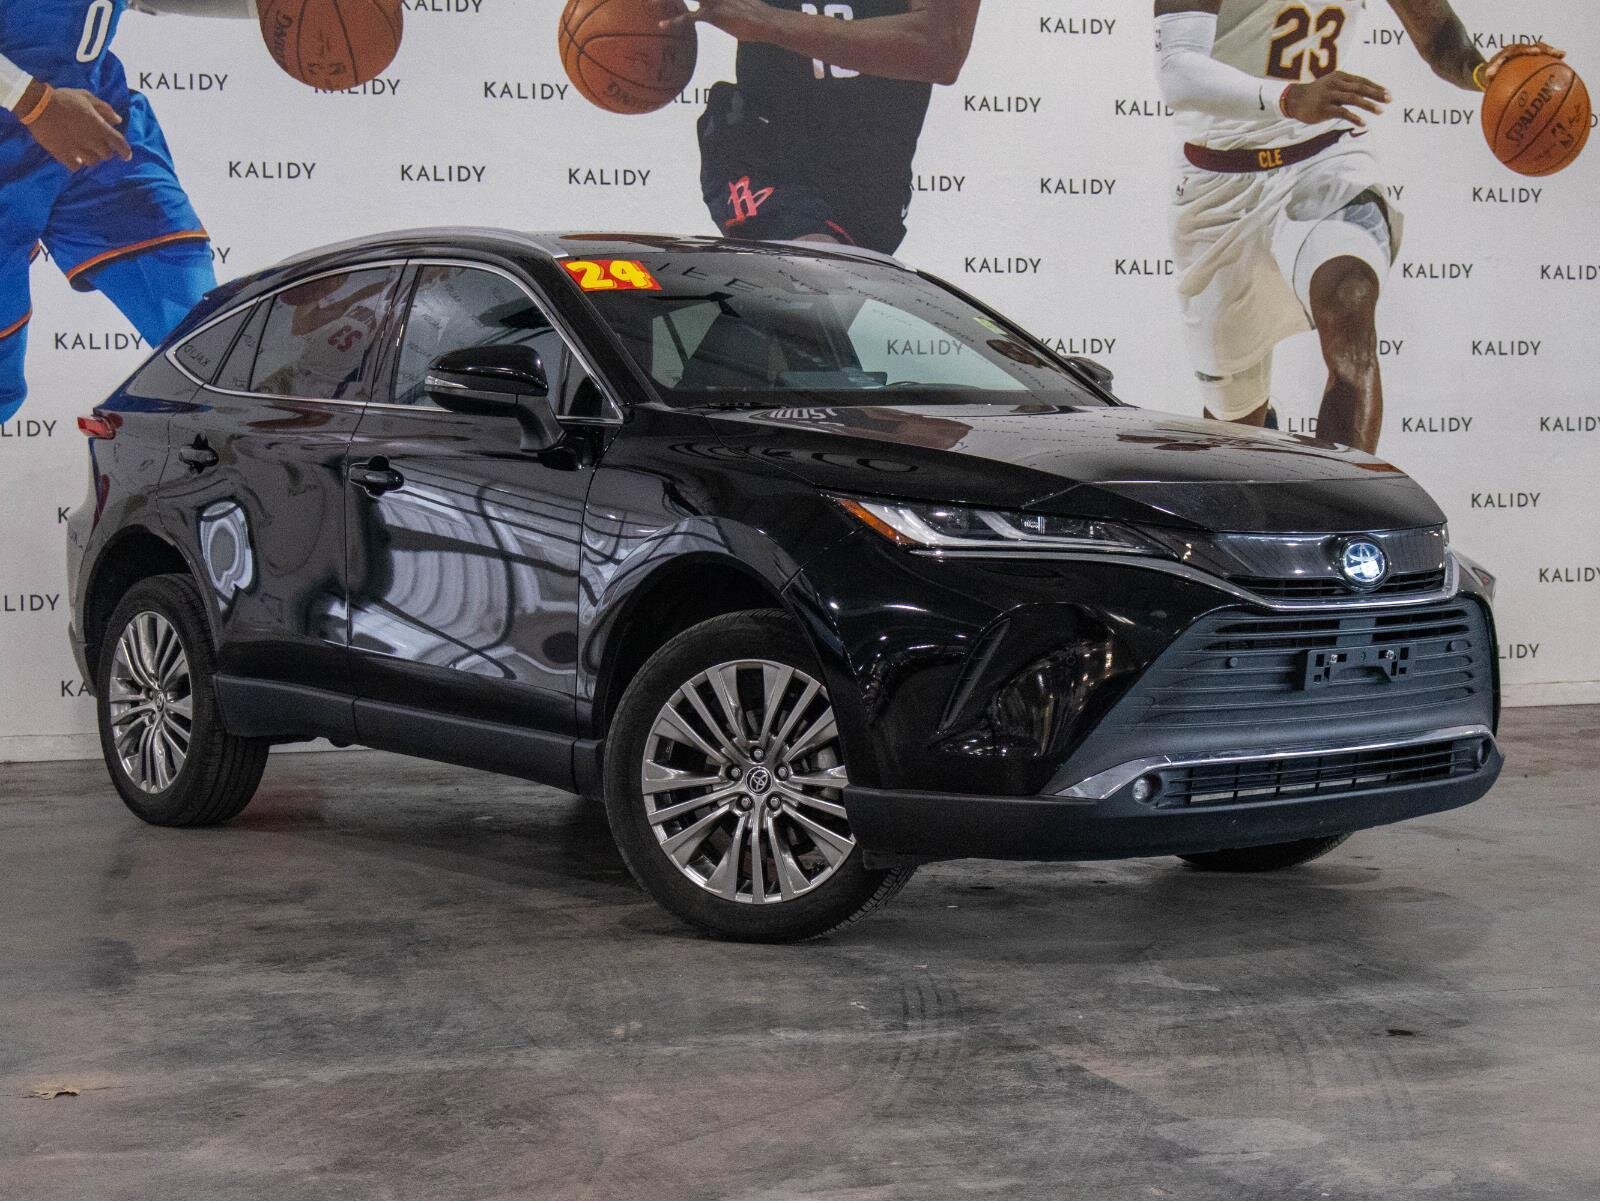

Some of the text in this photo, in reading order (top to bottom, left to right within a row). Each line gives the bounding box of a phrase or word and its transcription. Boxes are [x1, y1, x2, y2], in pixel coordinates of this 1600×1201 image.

[1041, 17, 1115, 35] KALIDY
[1265, 4, 1346, 80] 23
[1363, 29, 1404, 45] IDY
[1473, 33, 1543, 49] KALIDY
[140, 72, 228, 91] KALIDY
[484, 82, 568, 101] KALIDY
[965, 96, 1041, 113] KALIDY
[1404, 108, 1474, 125] KALIDY
[1258, 149, 1283, 169] CLE
[229, 161, 316, 180] KALIDY
[401, 165, 486, 183] KALIDY
[568, 168, 650, 186] KALIDY
[910, 175, 965, 191] LIDY
[1041, 178, 1116, 195] KALIDY
[1473, 187, 1542, 203] KALIDY
[965, 257, 1041, 274] KALIDY
[1116, 260, 1174, 275] KALID
[1403, 263, 1473, 279] KALIDY
[1541, 265, 1600, 280] KALID
[55, 333, 143, 350] KALIDY
[887, 339, 963, 355] KALIDY
[1472, 340, 1541, 356] KALIDY
[1, 420, 56, 437] LIDY
[1402, 417, 1472, 432] KALIDY
[1540, 416, 1600, 432] KALID
[1471, 493, 1541, 508] KALIDY
[1539, 567, 1600, 583] KALID
[4, 593, 59, 611] LIDY
